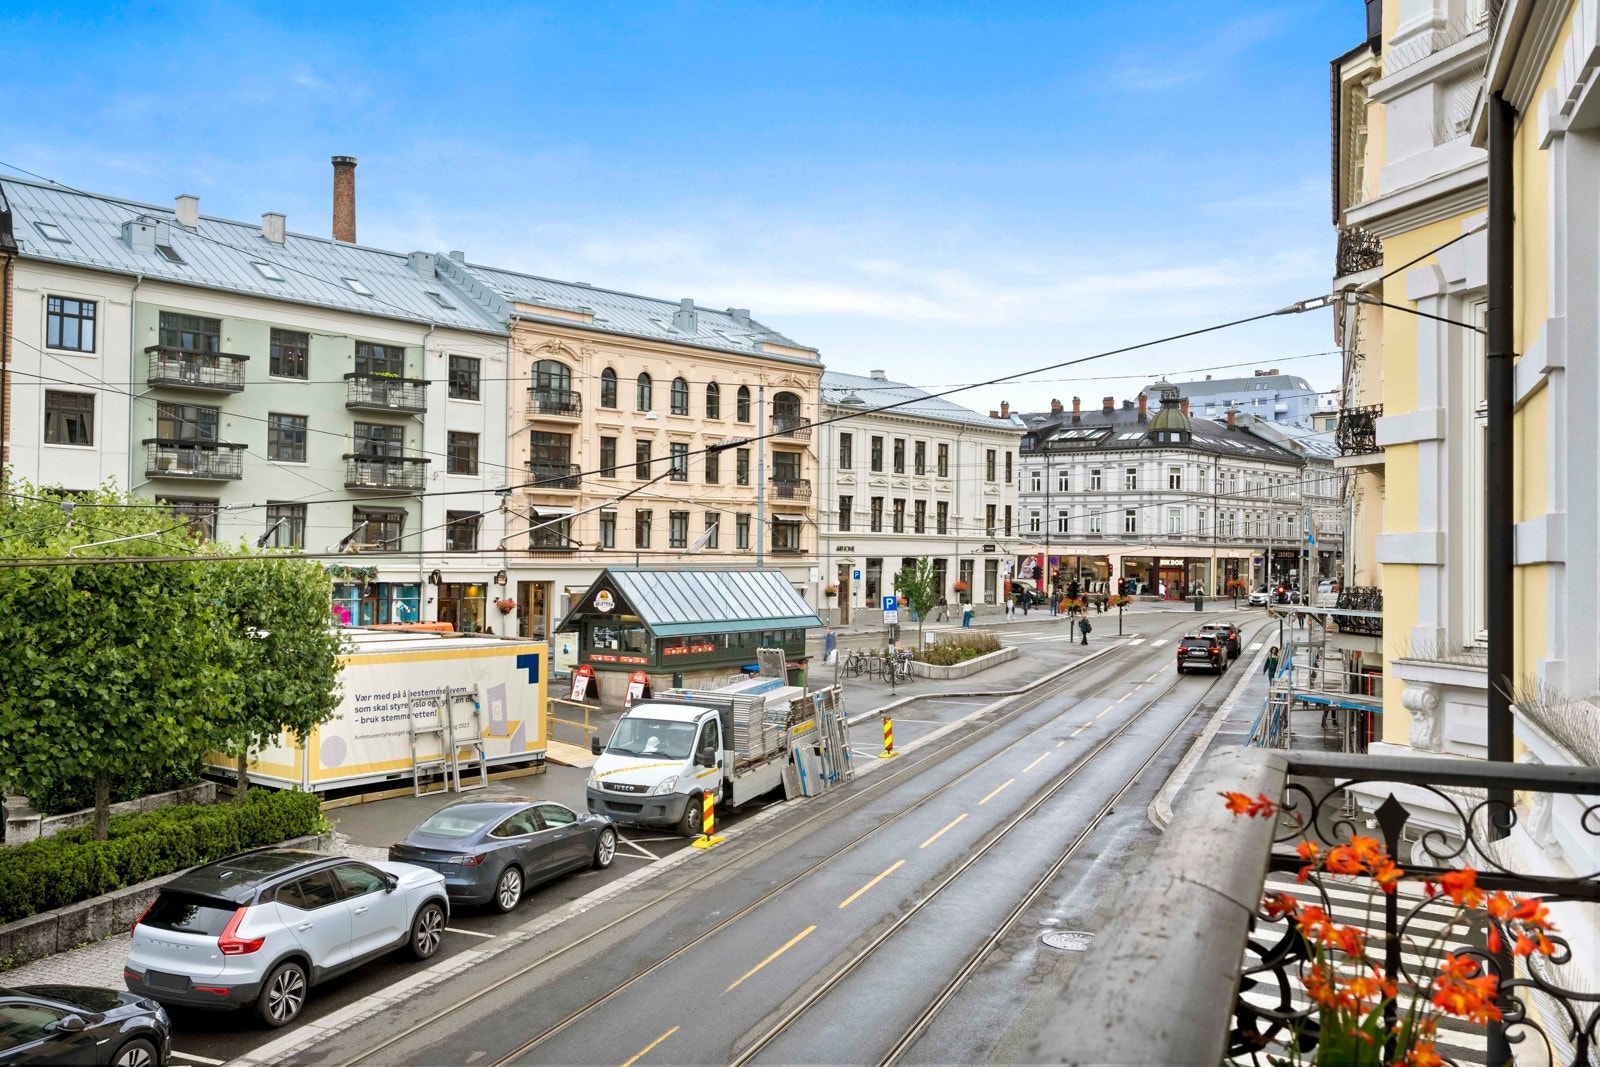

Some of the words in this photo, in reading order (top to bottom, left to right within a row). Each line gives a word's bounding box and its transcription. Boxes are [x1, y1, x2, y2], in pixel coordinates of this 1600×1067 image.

[886, 598, 894, 609] P
[355, 694, 372, 702] Vær
[373, 692, 391, 701] med
[393, 690, 401, 701] på
[403, 689, 407, 698] å
[355, 705, 371, 714] som
[373, 702, 389, 712] skal
[390, 700, 409, 711] styre
[361, 715, 379, 724] bruk
[613, 784, 635, 792] IVECO
